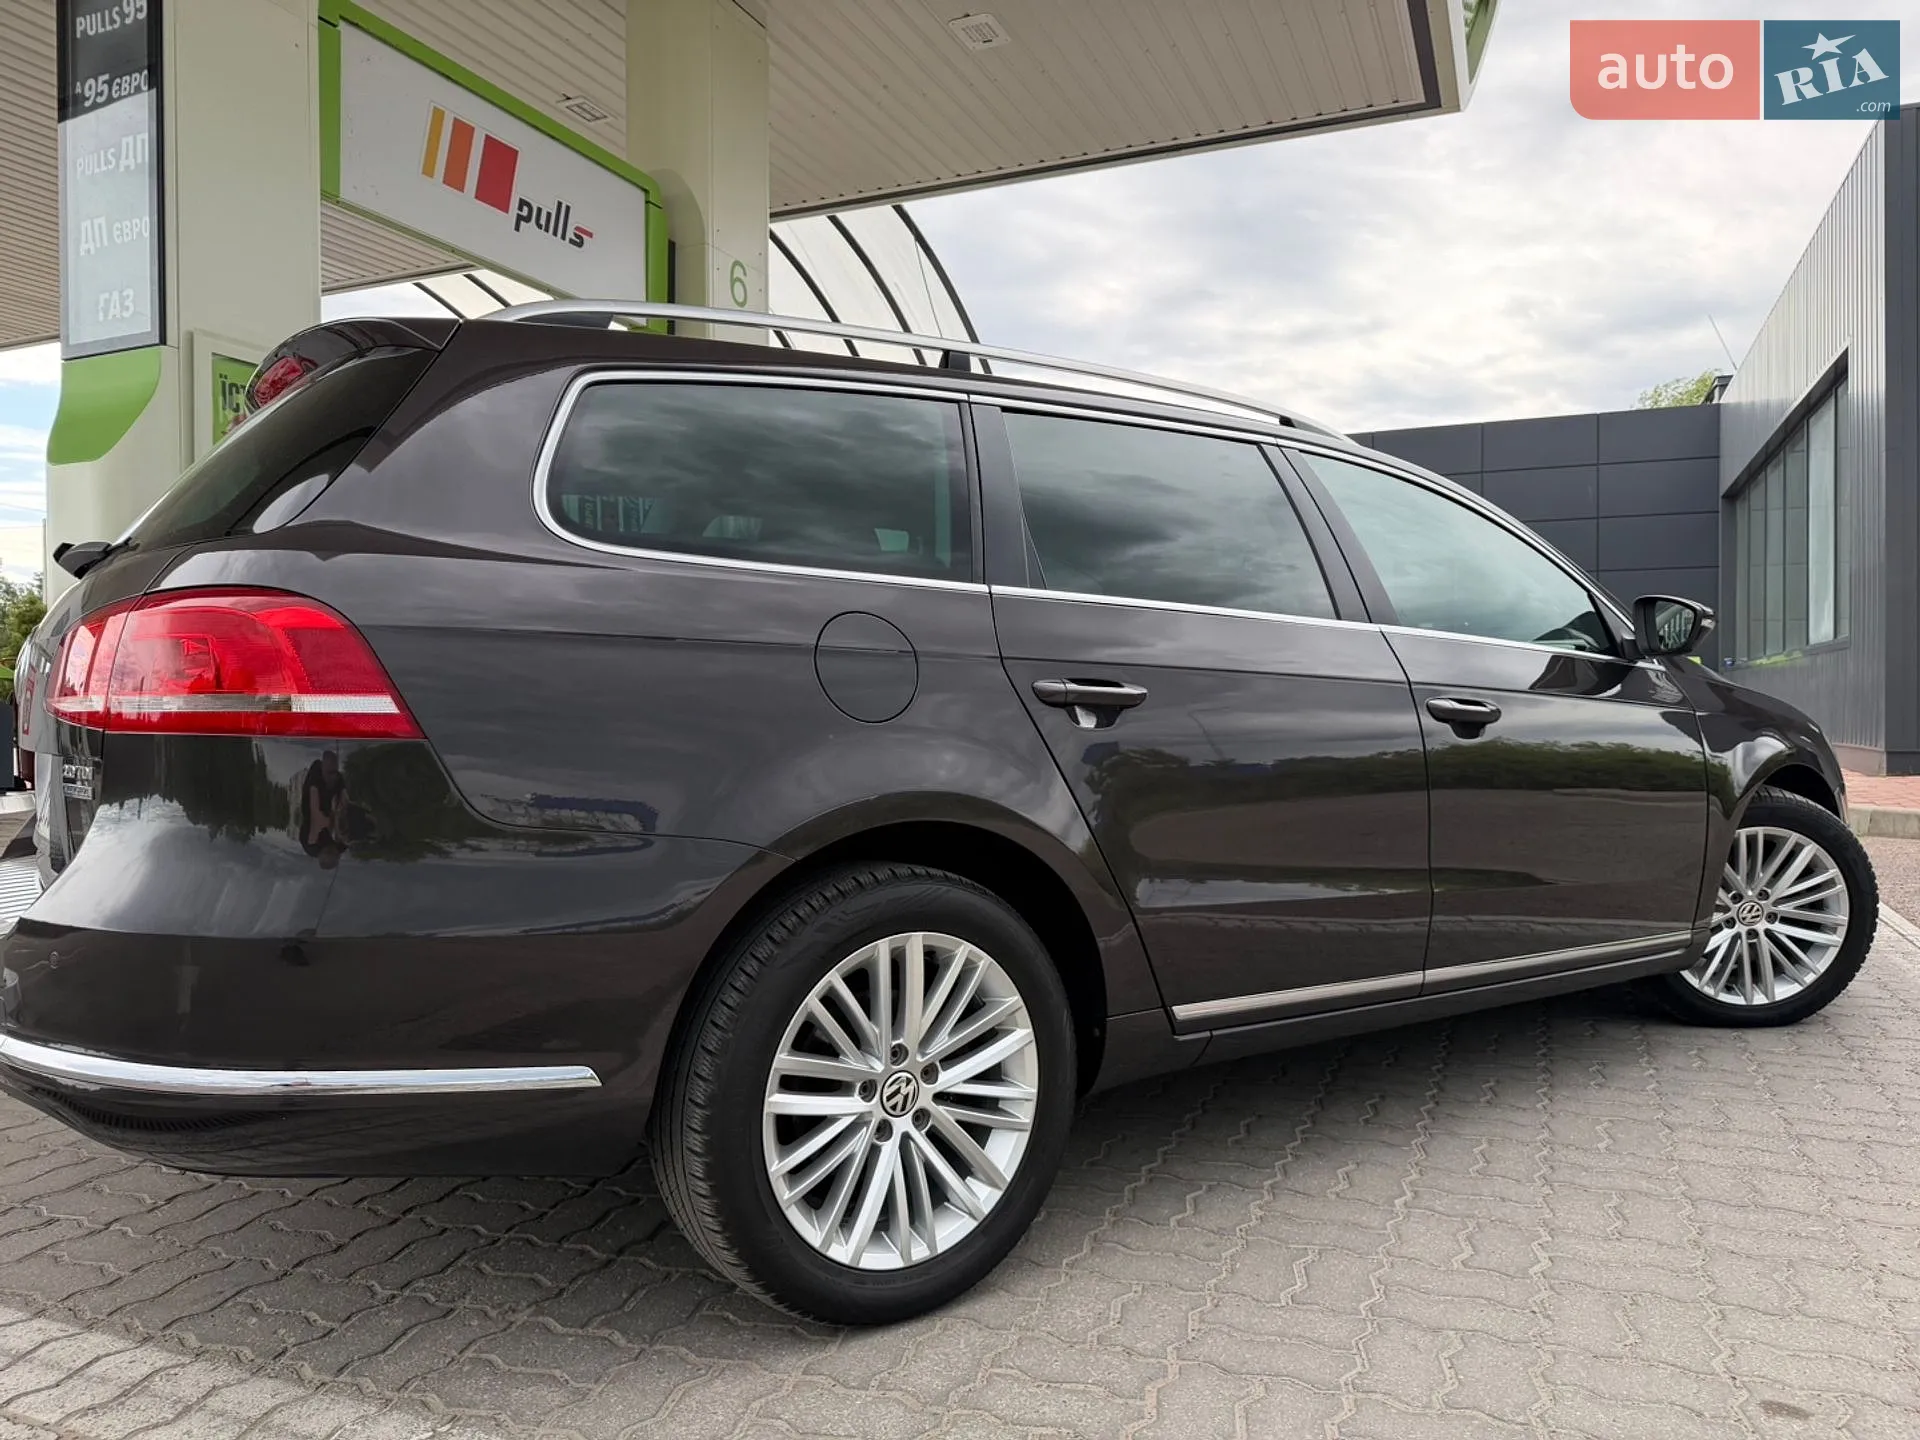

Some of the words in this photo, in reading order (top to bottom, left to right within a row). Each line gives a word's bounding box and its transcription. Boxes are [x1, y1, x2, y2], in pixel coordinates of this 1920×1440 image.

[75, 6, 121, 39] PULLS
[122, 0, 148, 24] 95
[83, 73, 110, 107] 95
[76, 147, 116, 179] PULLS
[80, 216, 109, 256] ДП
[514, 197, 594, 248] pulls
[730, 260, 748, 308] 6
[98, 287, 135, 322] ГАЗ
